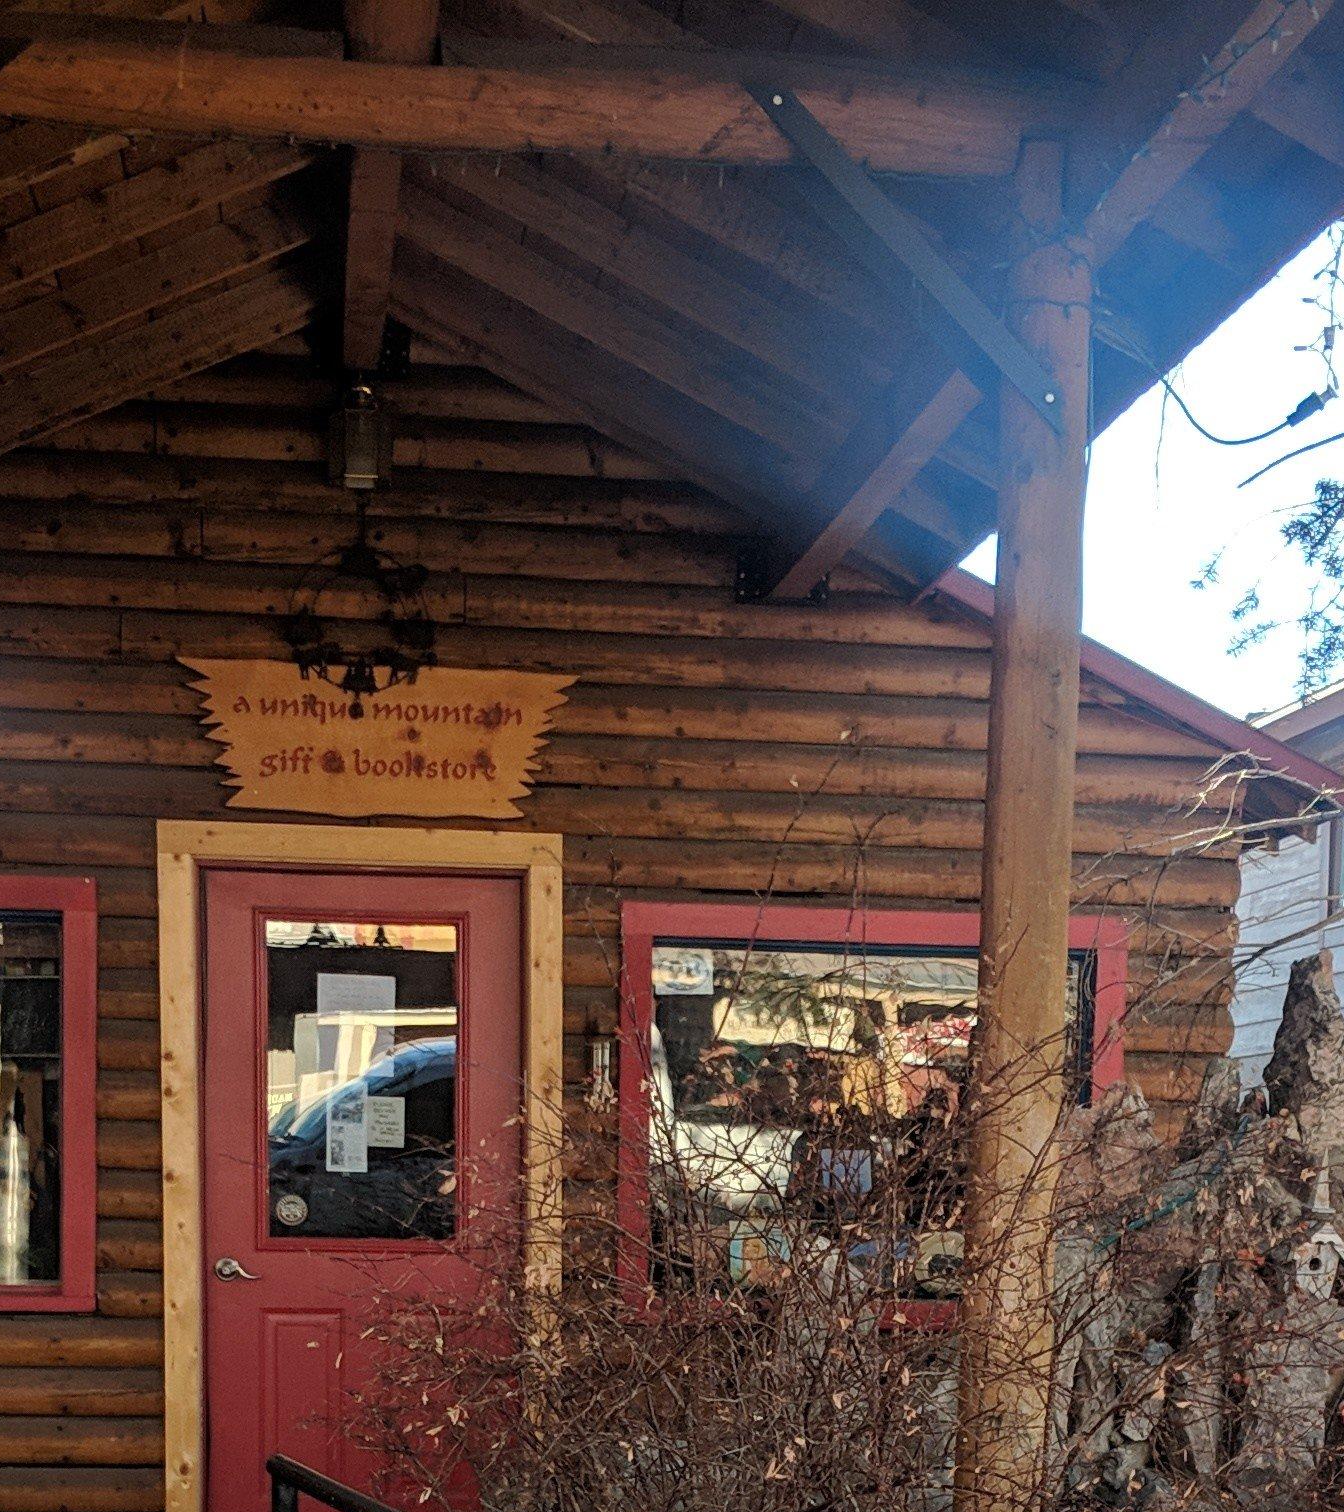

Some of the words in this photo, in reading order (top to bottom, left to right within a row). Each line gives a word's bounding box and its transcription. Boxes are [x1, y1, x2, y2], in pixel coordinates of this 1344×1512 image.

[232, 696, 252, 714] a
[259, 693, 365, 725] uniqu
[259, 746, 315, 778] gift
[353, 748, 498, 781] bookstore
